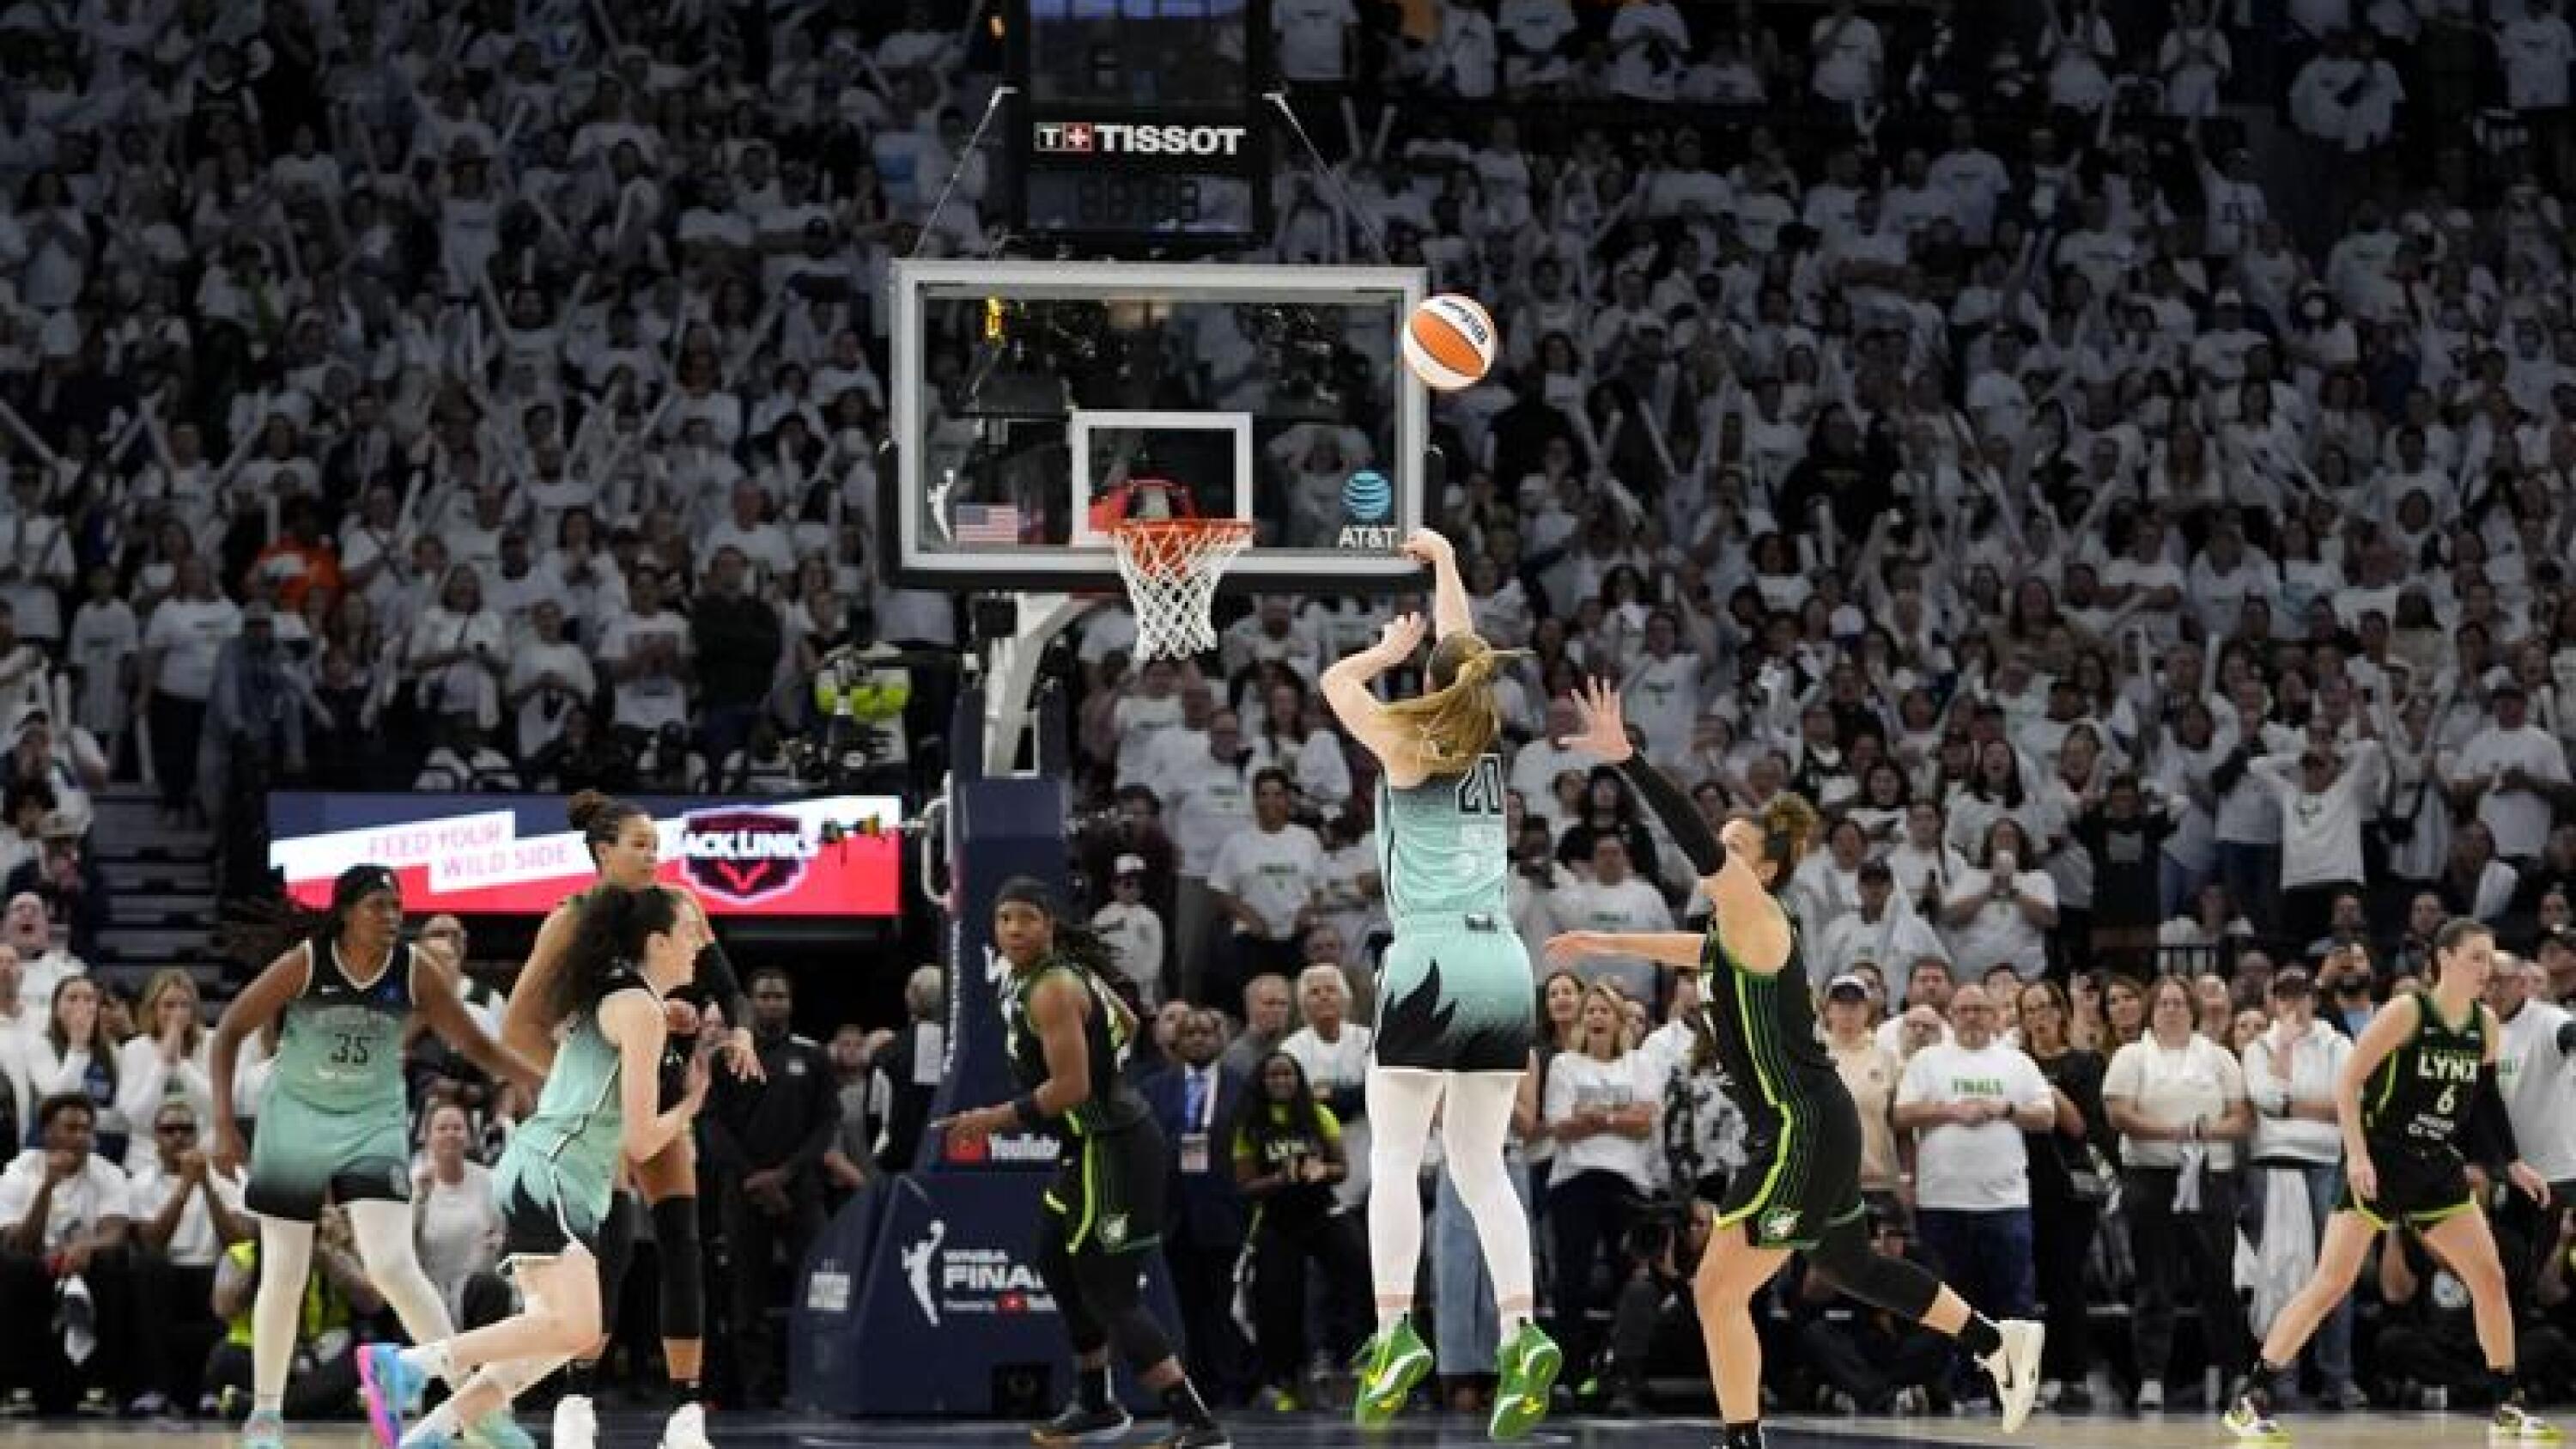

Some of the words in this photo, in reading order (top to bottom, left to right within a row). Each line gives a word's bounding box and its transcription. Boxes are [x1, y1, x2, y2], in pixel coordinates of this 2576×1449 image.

[1094, 125, 1247, 155] TISSOT
[1338, 527, 1399, 549] AT&T
[368, 831, 432, 857] FEED
[438, 820, 503, 849] YOUR
[442, 849, 507, 878] WILD
[514, 842, 569, 870] SIDE
[329, 1032, 373, 1066] 35
[2435, 1084, 2457, 1115] 6
